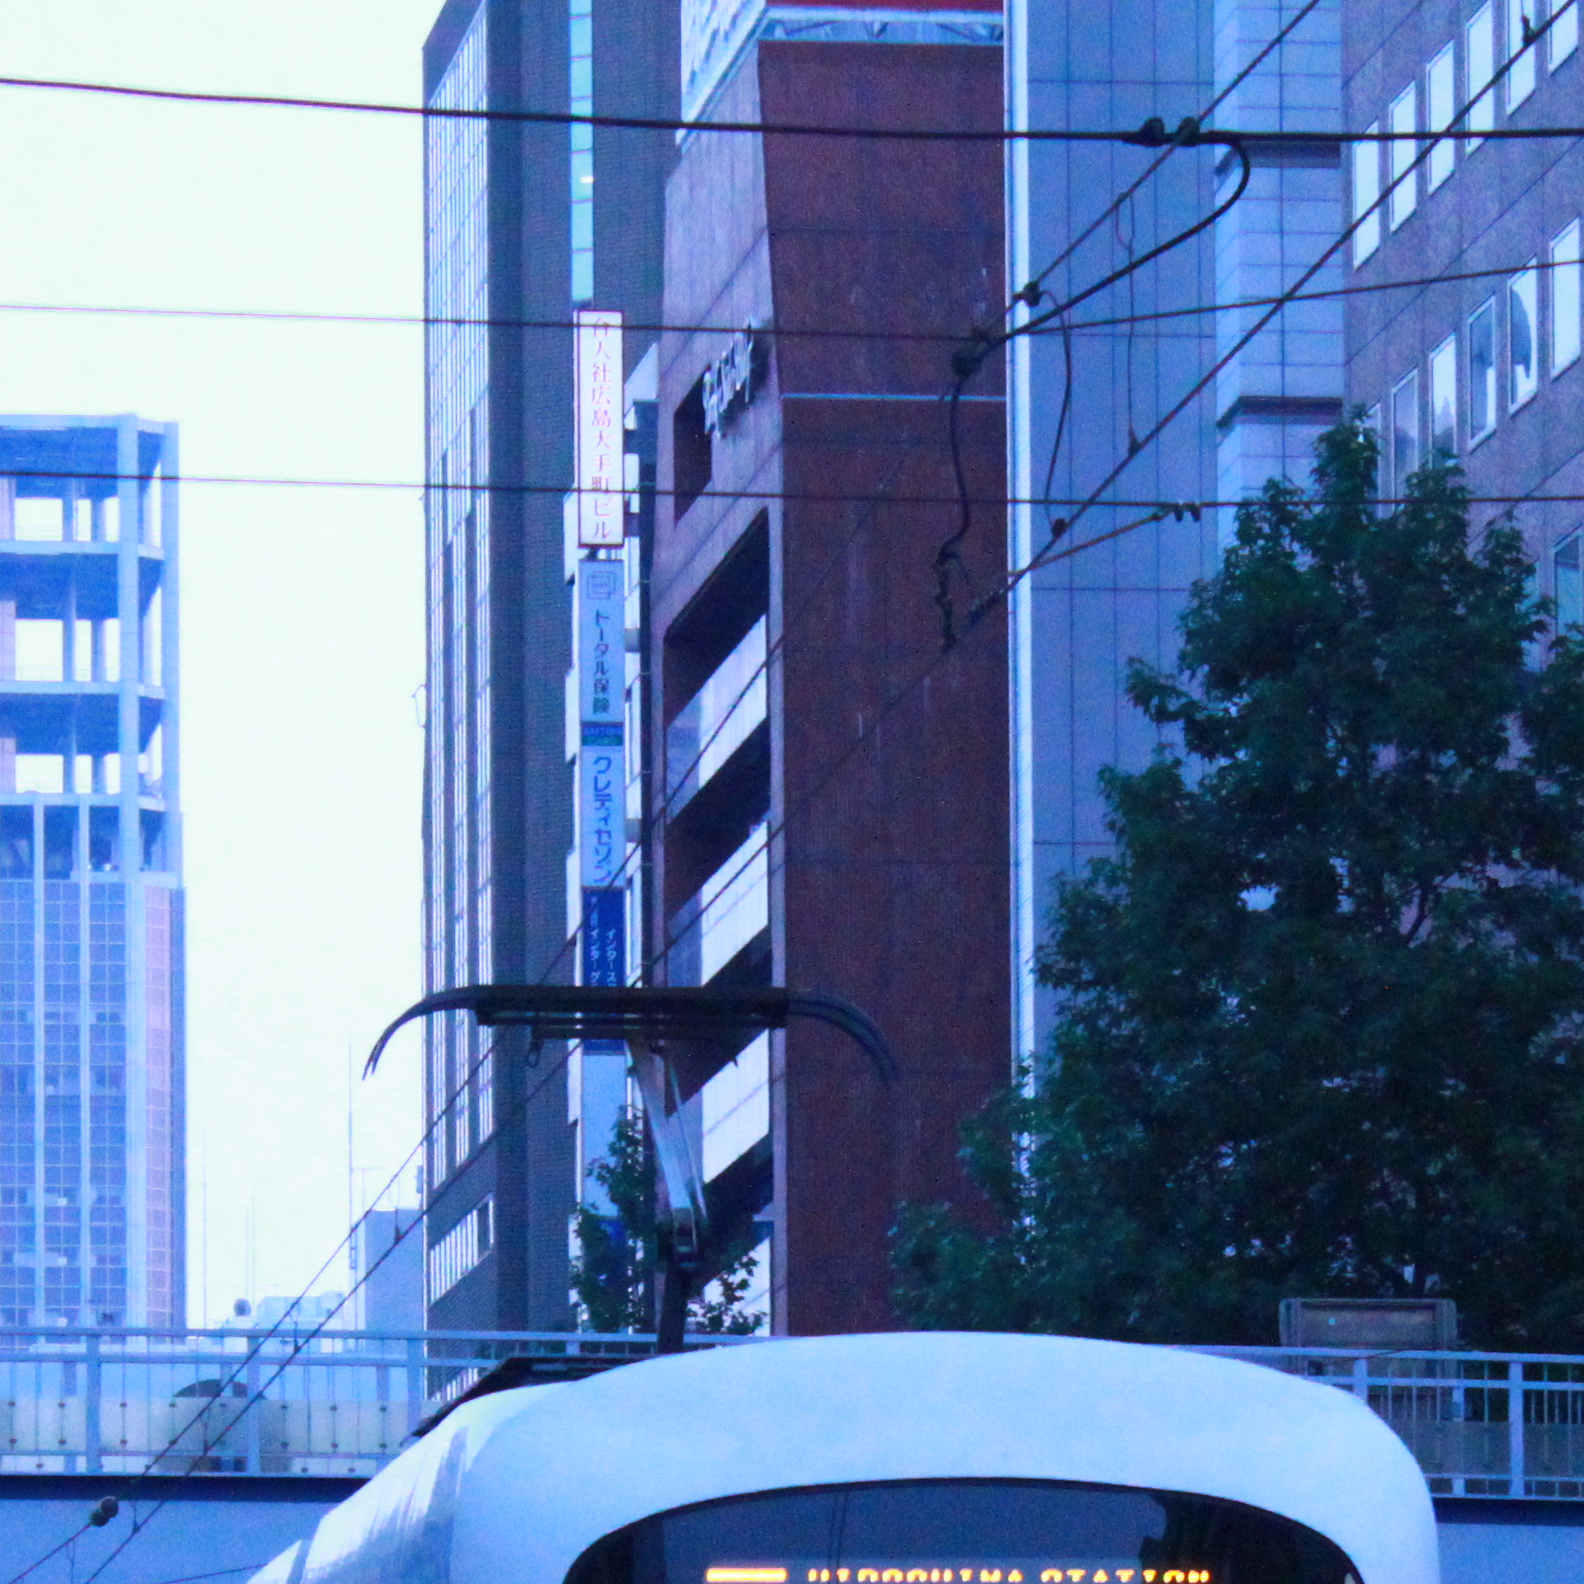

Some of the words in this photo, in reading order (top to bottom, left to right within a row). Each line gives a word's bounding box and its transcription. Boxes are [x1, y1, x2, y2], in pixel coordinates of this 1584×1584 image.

[592, 609, 611, 715] トータル保険
